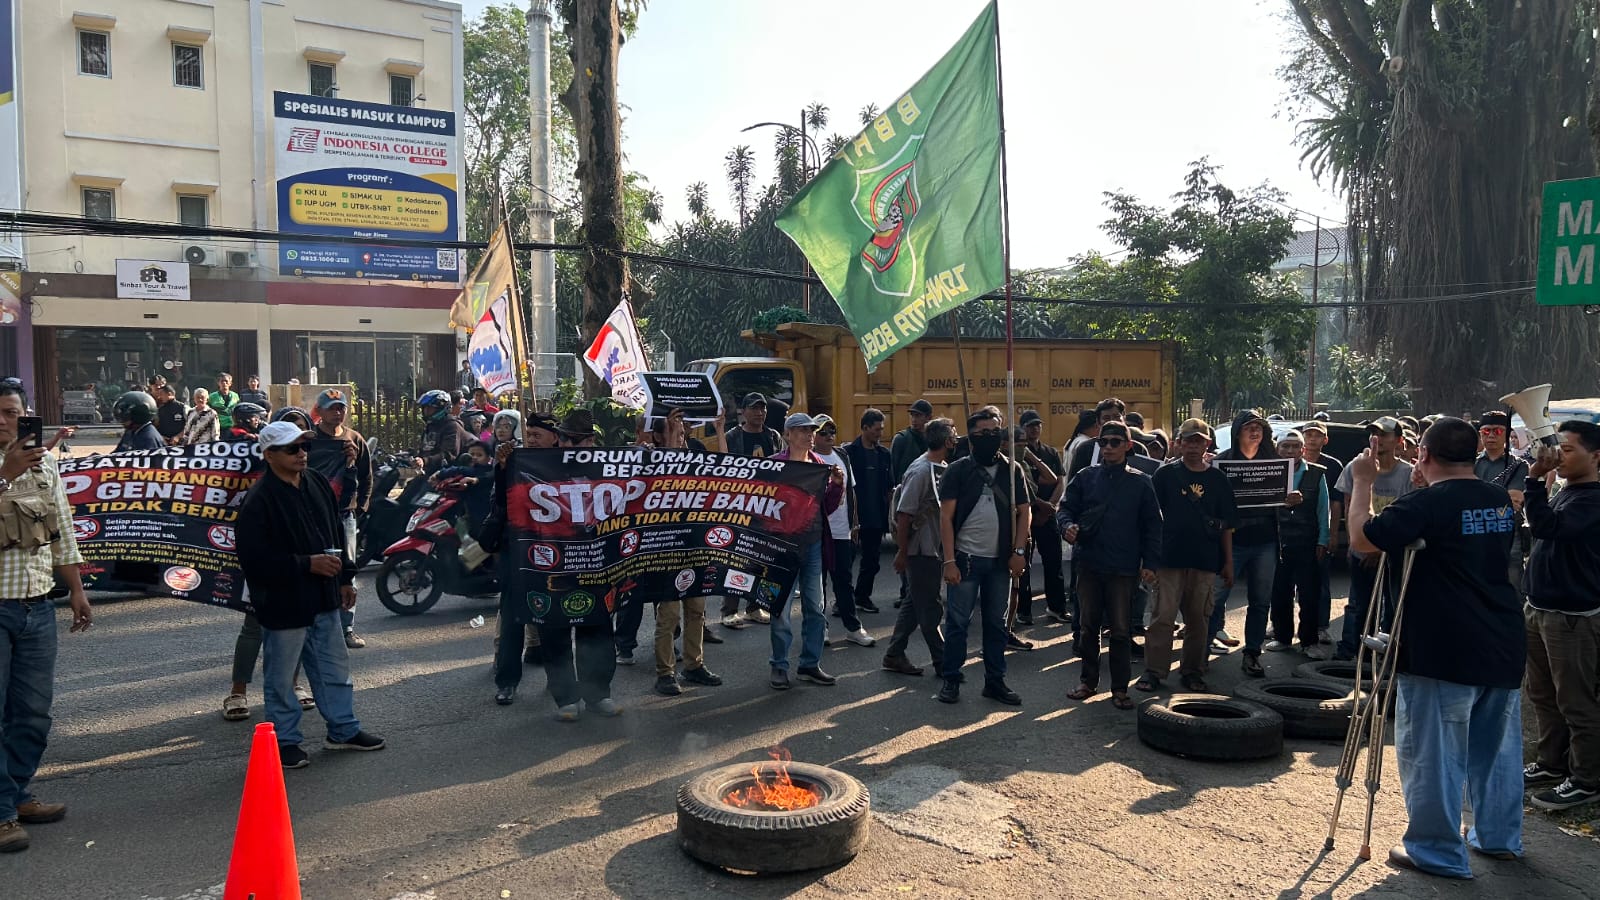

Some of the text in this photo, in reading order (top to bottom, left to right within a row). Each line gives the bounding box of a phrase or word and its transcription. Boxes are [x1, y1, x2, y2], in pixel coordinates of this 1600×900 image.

[351, 108, 394, 122] MASUK
[397, 113, 446, 128] KAMPUS
[324, 137, 447, 158] INDONESIA COLLEGE
[350, 203, 392, 212] UTBK-SNBT
[1557, 200, 1600, 236] M
[928, 379, 958, 388] DINAS
[1052, 378, 1072, 388] DAN
[162, 456, 251, 474] (FOBB)
[562, 450, 786, 472] FORUM ORMAS BOGOR
[602, 463, 757, 480] BERSATU (FOBB)
[96, 482, 194, 502] GENE
[651, 479, 779, 497] PEMBANGUNAN
[85, 500, 163, 513] TIDAK
[529, 479, 646, 523] STOP
[643, 491, 786, 521] GENE BANK
[596, 512, 752, 535] YANG TIDAK BERIJIN
[130, 549, 173, 557] memiliki
[176, 553, 220, 564] perizinan
[140, 542, 180, 550] berlaku
[183, 547, 210, 557] untuk
[154, 557, 195, 569] pandang
[198, 563, 222, 572] bulu!
